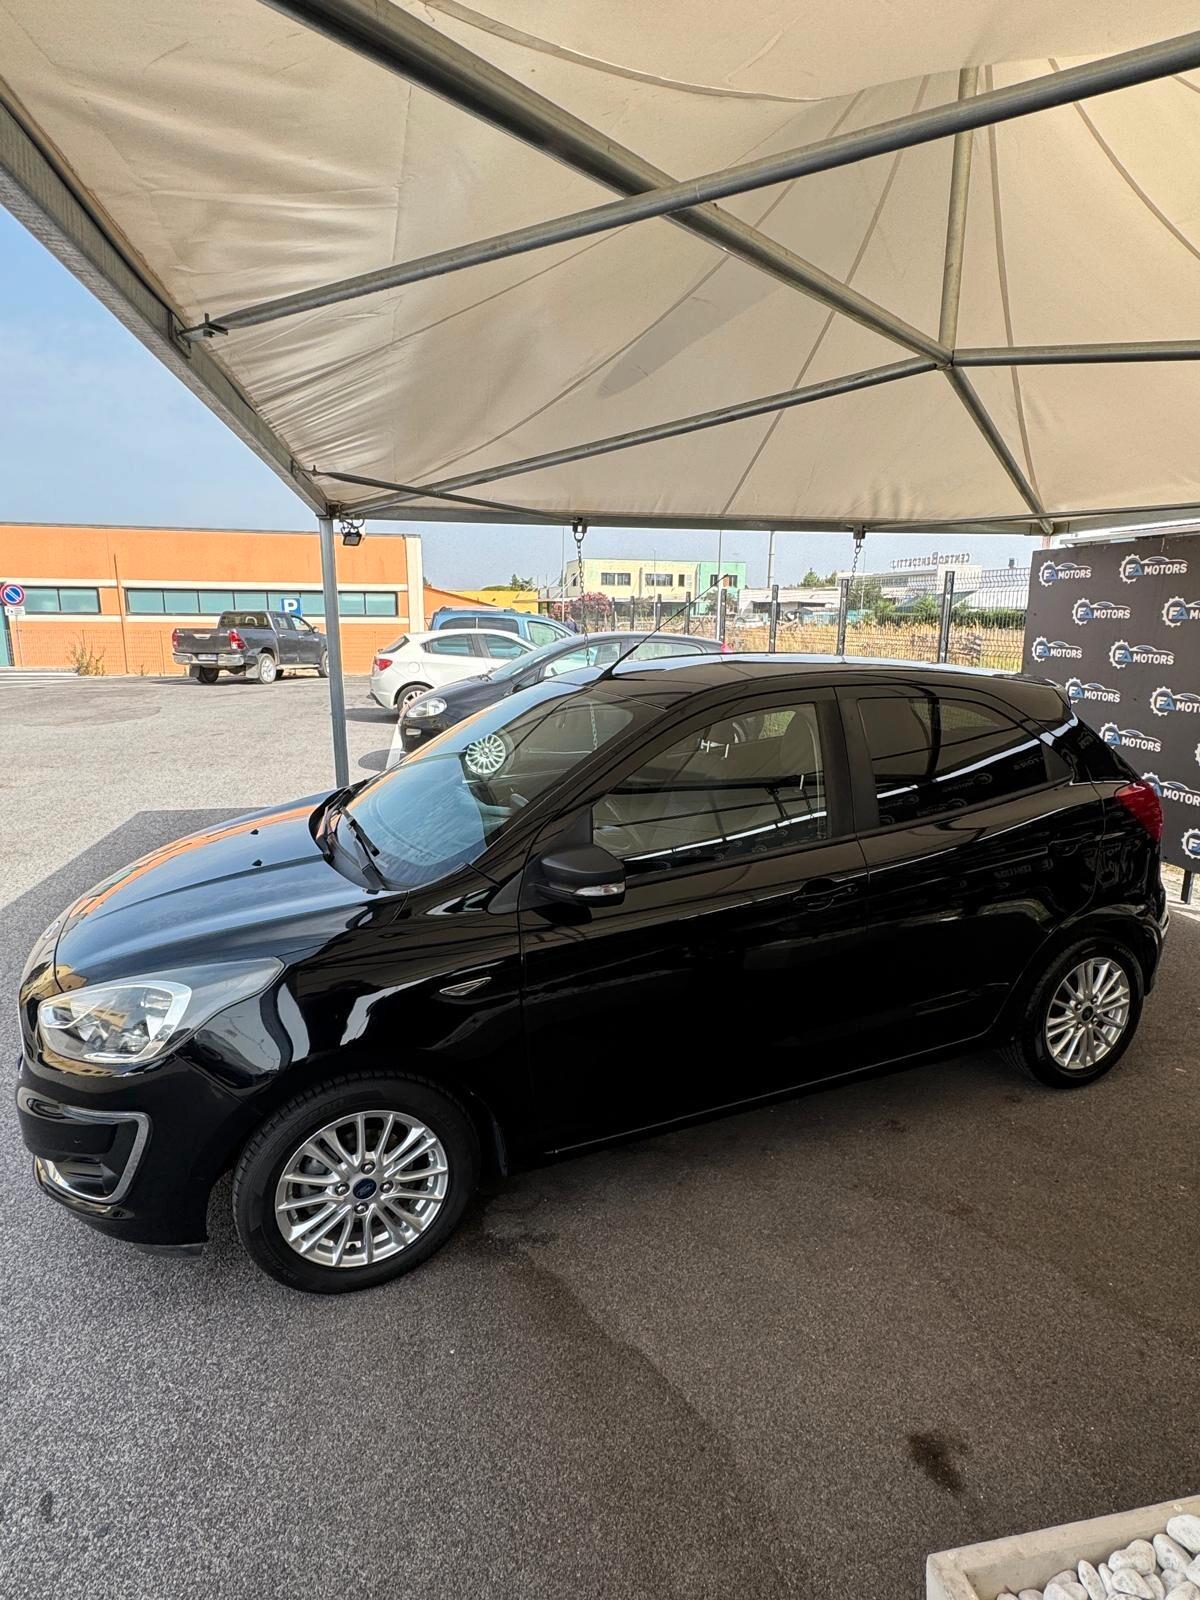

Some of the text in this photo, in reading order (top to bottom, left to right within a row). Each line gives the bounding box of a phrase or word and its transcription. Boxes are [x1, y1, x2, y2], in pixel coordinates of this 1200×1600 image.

[1058, 569, 1092, 580] MOTORS
[1143, 563, 1188, 576] MOTORS
[284, 599, 298, 613] P
[1093, 609, 1131, 619] MOTORS
[1050, 647, 1083, 659] MOTORS
[1132, 652, 1175, 665] MOTORS
[1084, 690, 1121, 703] MOTORS
[1175, 701, 1200, 713] MOT
[1121, 736, 1162, 752] MOTORS
